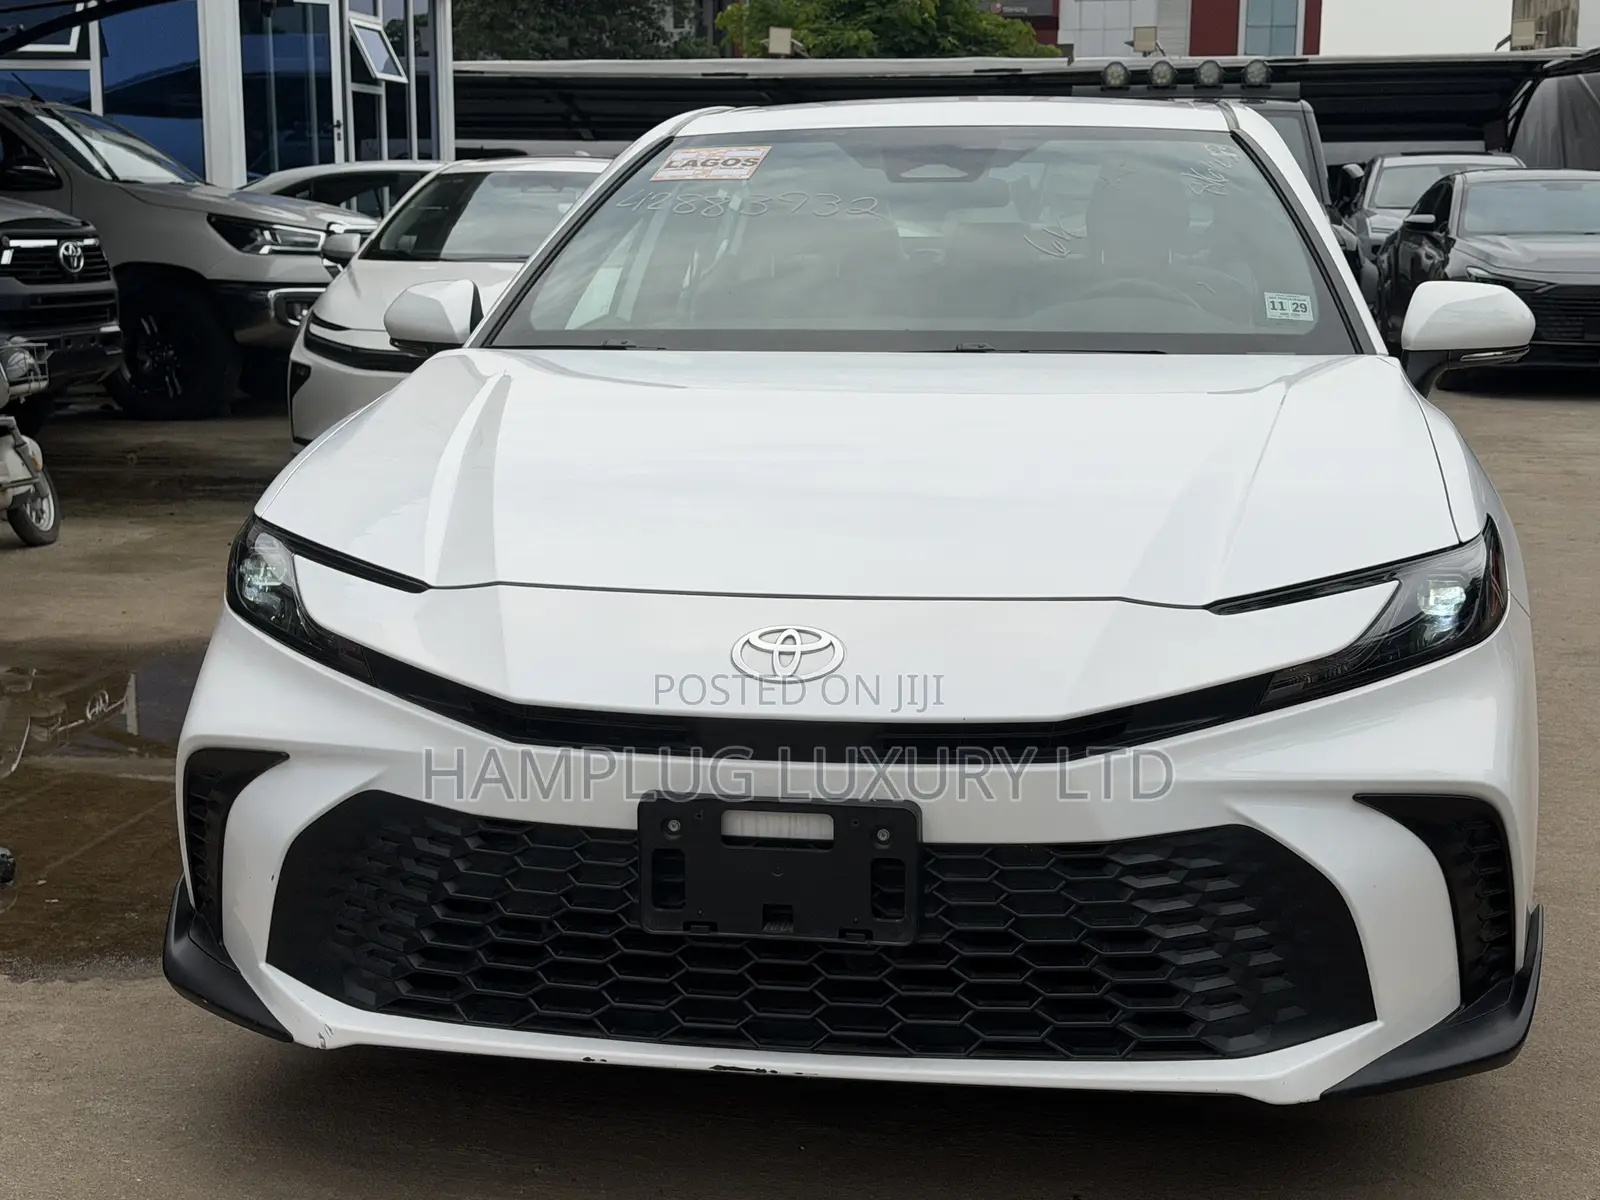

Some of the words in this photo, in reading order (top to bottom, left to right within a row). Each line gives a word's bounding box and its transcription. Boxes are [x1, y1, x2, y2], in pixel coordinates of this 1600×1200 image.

[663, 157, 761, 169] LAGOS
[1270, 300, 1286, 311] 11
[1292, 302, 1308, 313] 29
